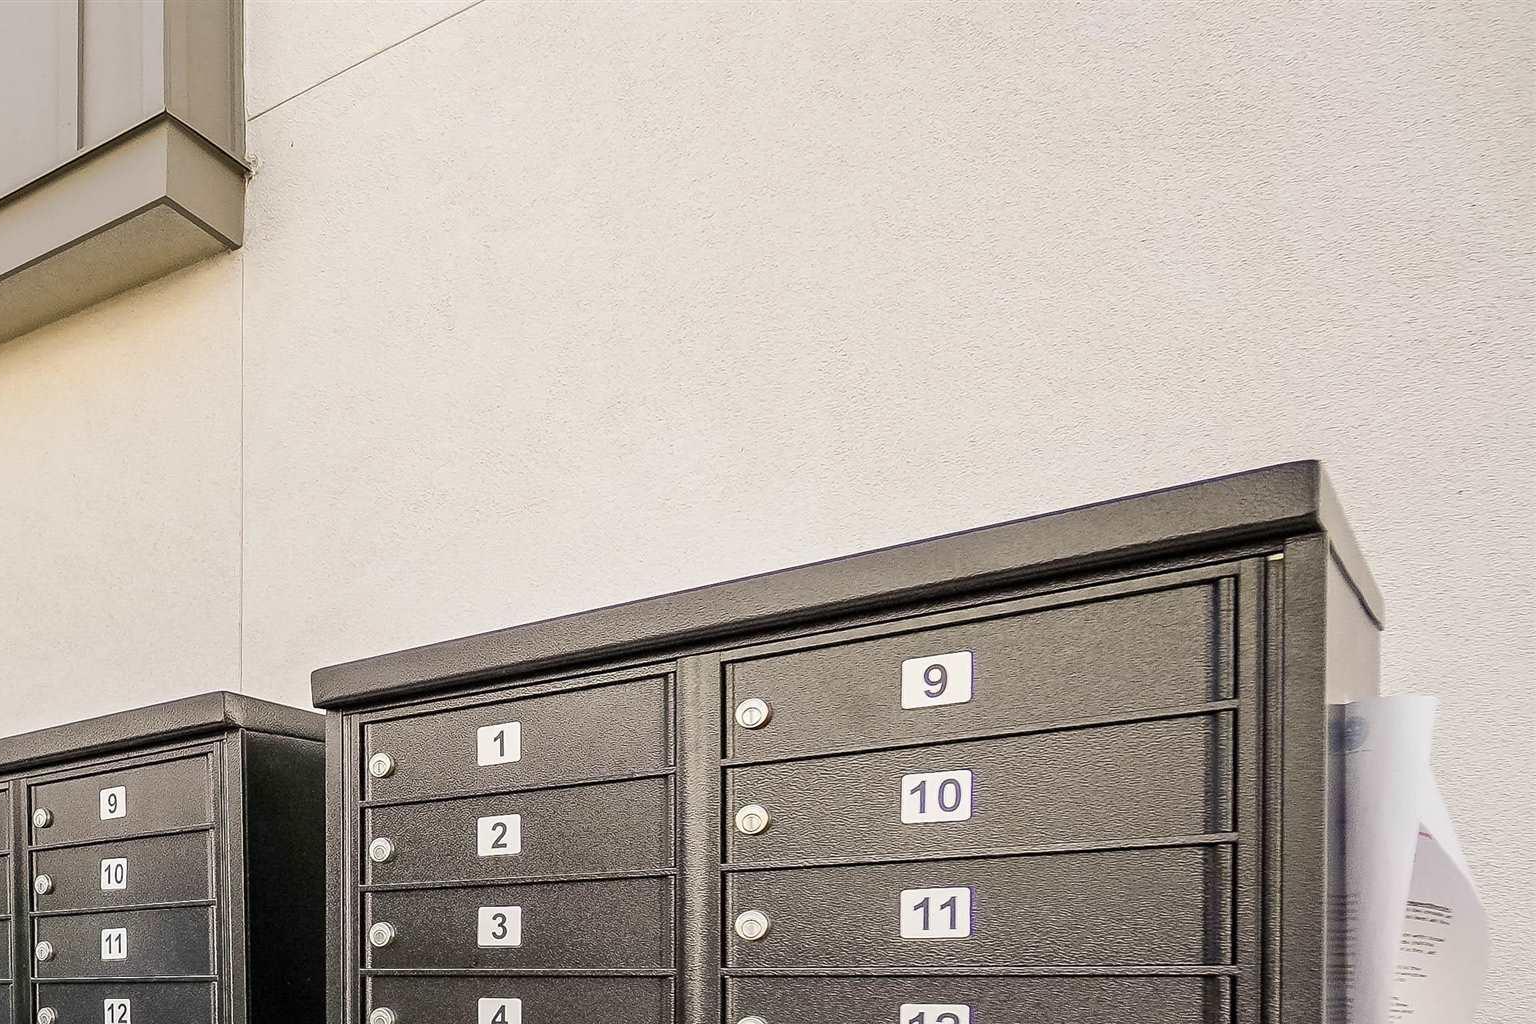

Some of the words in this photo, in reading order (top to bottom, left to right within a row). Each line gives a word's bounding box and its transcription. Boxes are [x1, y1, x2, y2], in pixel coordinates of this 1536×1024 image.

[923, 663, 948, 699] 9
[493, 730, 505, 758] 1
[107, 792, 118, 814] 9
[909, 778, 962, 814] 10
[491, 821, 508, 849] 2
[104, 863, 124, 885] 10
[491, 912, 508, 940] 3
[913, 895, 957, 931] 11
[105, 933, 122, 955] 11
[107, 1002, 128, 1024] 12
